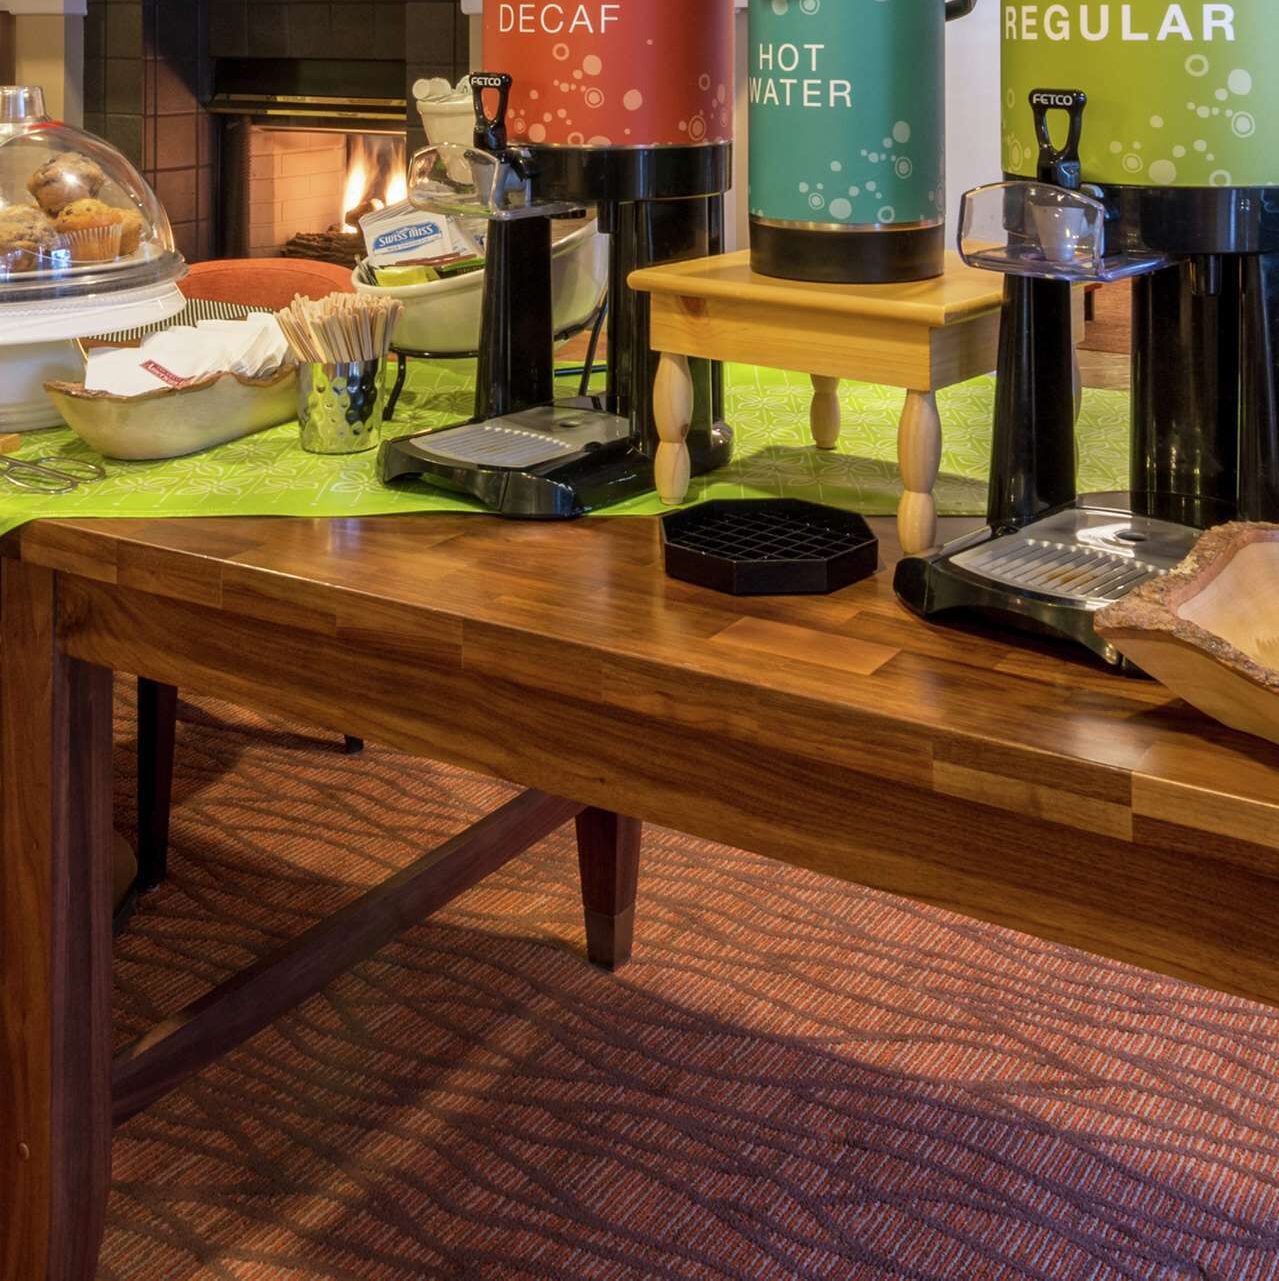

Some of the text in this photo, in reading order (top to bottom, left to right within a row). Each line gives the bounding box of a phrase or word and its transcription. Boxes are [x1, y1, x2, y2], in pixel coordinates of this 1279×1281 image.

[498, 3, 621, 34] DECAF
[1005, 3, 1236, 42] REGULAR
[759, 43, 825, 72] HOT
[471, 76, 501, 87] FETCO
[749, 77, 852, 108] WATER
[1032, 93, 1073, 106] FETCO
